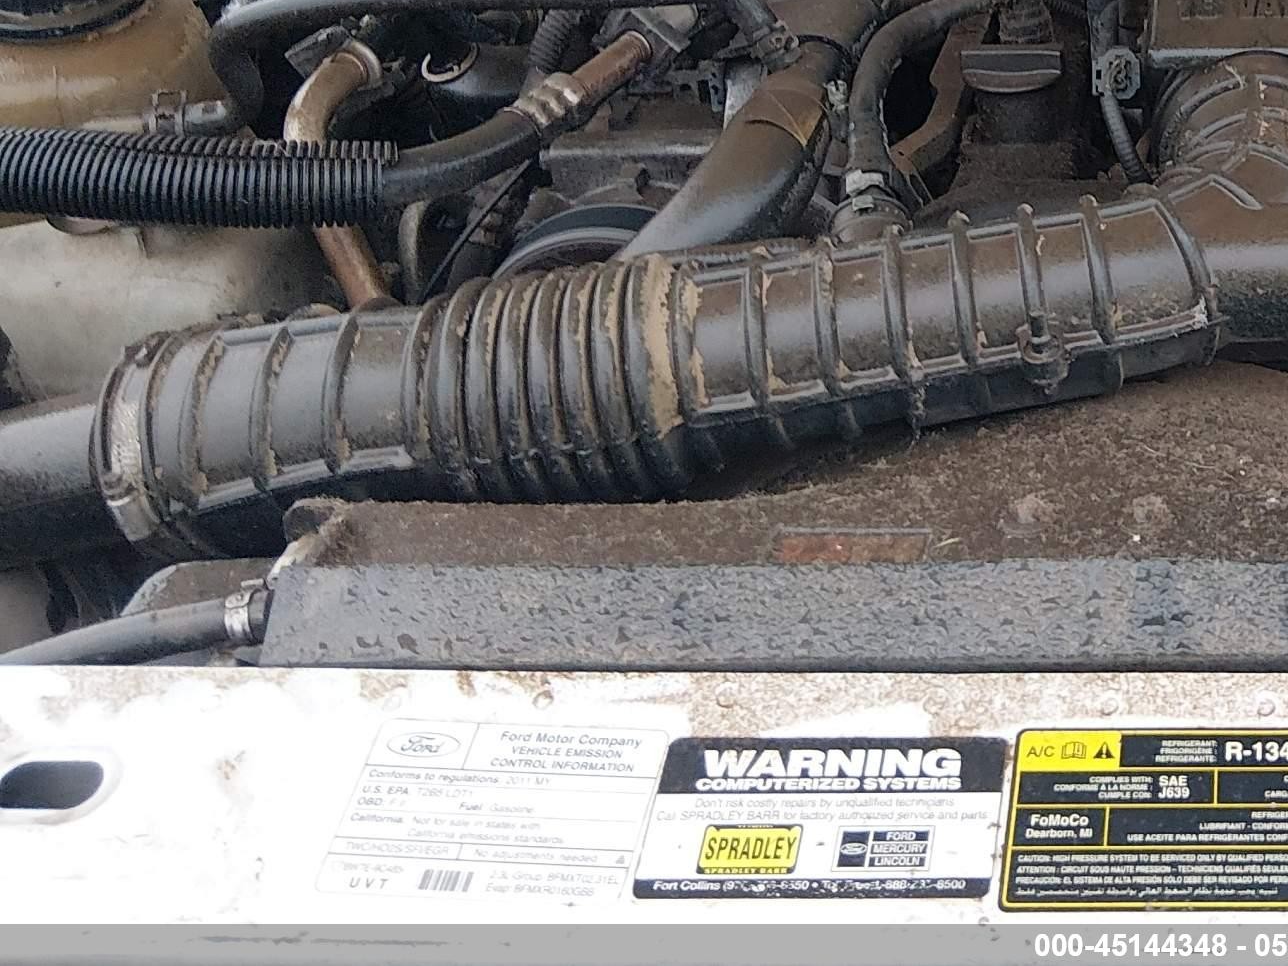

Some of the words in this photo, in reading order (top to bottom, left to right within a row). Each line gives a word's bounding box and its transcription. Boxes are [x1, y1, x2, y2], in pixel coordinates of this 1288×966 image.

[400, 735, 443, 754] Ford
[500, 731, 532, 742] Ford
[535, 732, 576, 745] Motor
[579, 734, 643, 748] Company
[511, 745, 561, 757] VEHICLE
[565, 746, 623, 759] EMISSION
[1026, 745, 1055, 757] A/C
[490, 757, 547, 770] CONTROL
[551, 759, 635, 772] INFORMATION
[703, 748, 962, 778] WARNING
[368, 769, 421, 782] Conforms
[424, 771, 436, 782] to
[1159, 775, 1188, 786] SAE
[695, 777, 861, 792] COMPUTERIZED
[863, 777, 962, 792] SYSTEMS
[1158, 786, 1190, 799] J639
[695, 798, 722, 808] Don't
[725, 798, 743, 808] risk
[746, 798, 778, 810] costly
[781, 798, 816, 810] repairs
[819, 798, 831, 809] by
[835, 797, 893, 809] unqualified
[680, 810, 743, 821] SPRADLEY
[746, 810, 780, 820] BARR
[896, 810, 935, 821] service
[937, 810, 958, 820] and
[960, 810, 988, 821] parts
[1030, 814, 1089, 827] FoMoCo
[886, 831, 917, 841] FORD
[1025, 828, 1077, 839] Dearborn,
[1079, 828, 1093, 838] MI
[705, 836, 798, 860] SPRADLEY
[872, 843, 926, 853] MERCURY
[874, 856, 920, 866] LINCOLN
[653, 880, 679, 891] Fort
[680, 880, 721, 891] Collins
